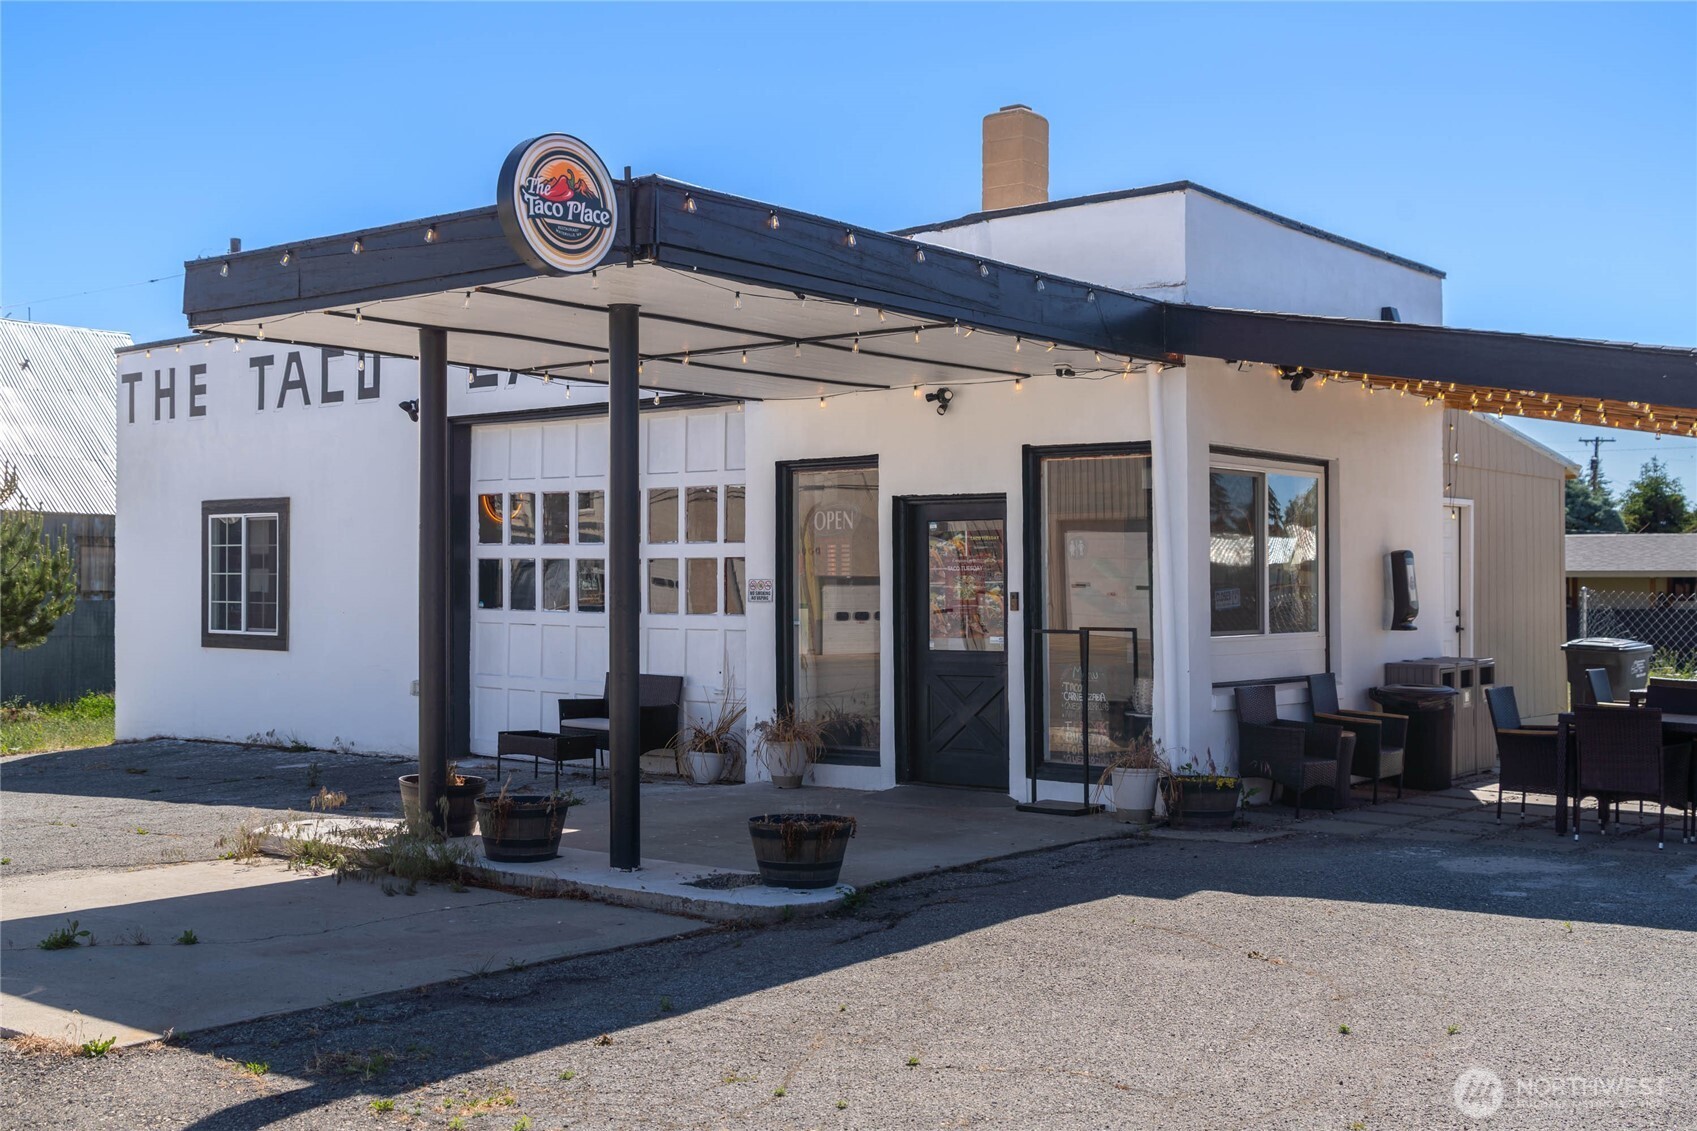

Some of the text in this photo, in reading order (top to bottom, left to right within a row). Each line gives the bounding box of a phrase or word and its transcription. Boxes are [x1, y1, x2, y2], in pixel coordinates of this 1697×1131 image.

[526, 176, 552, 197] The
[522, 188, 610, 225] Taco Place
[121, 347, 381, 424] THE TACO
[814, 510, 854, 531] OPEN
